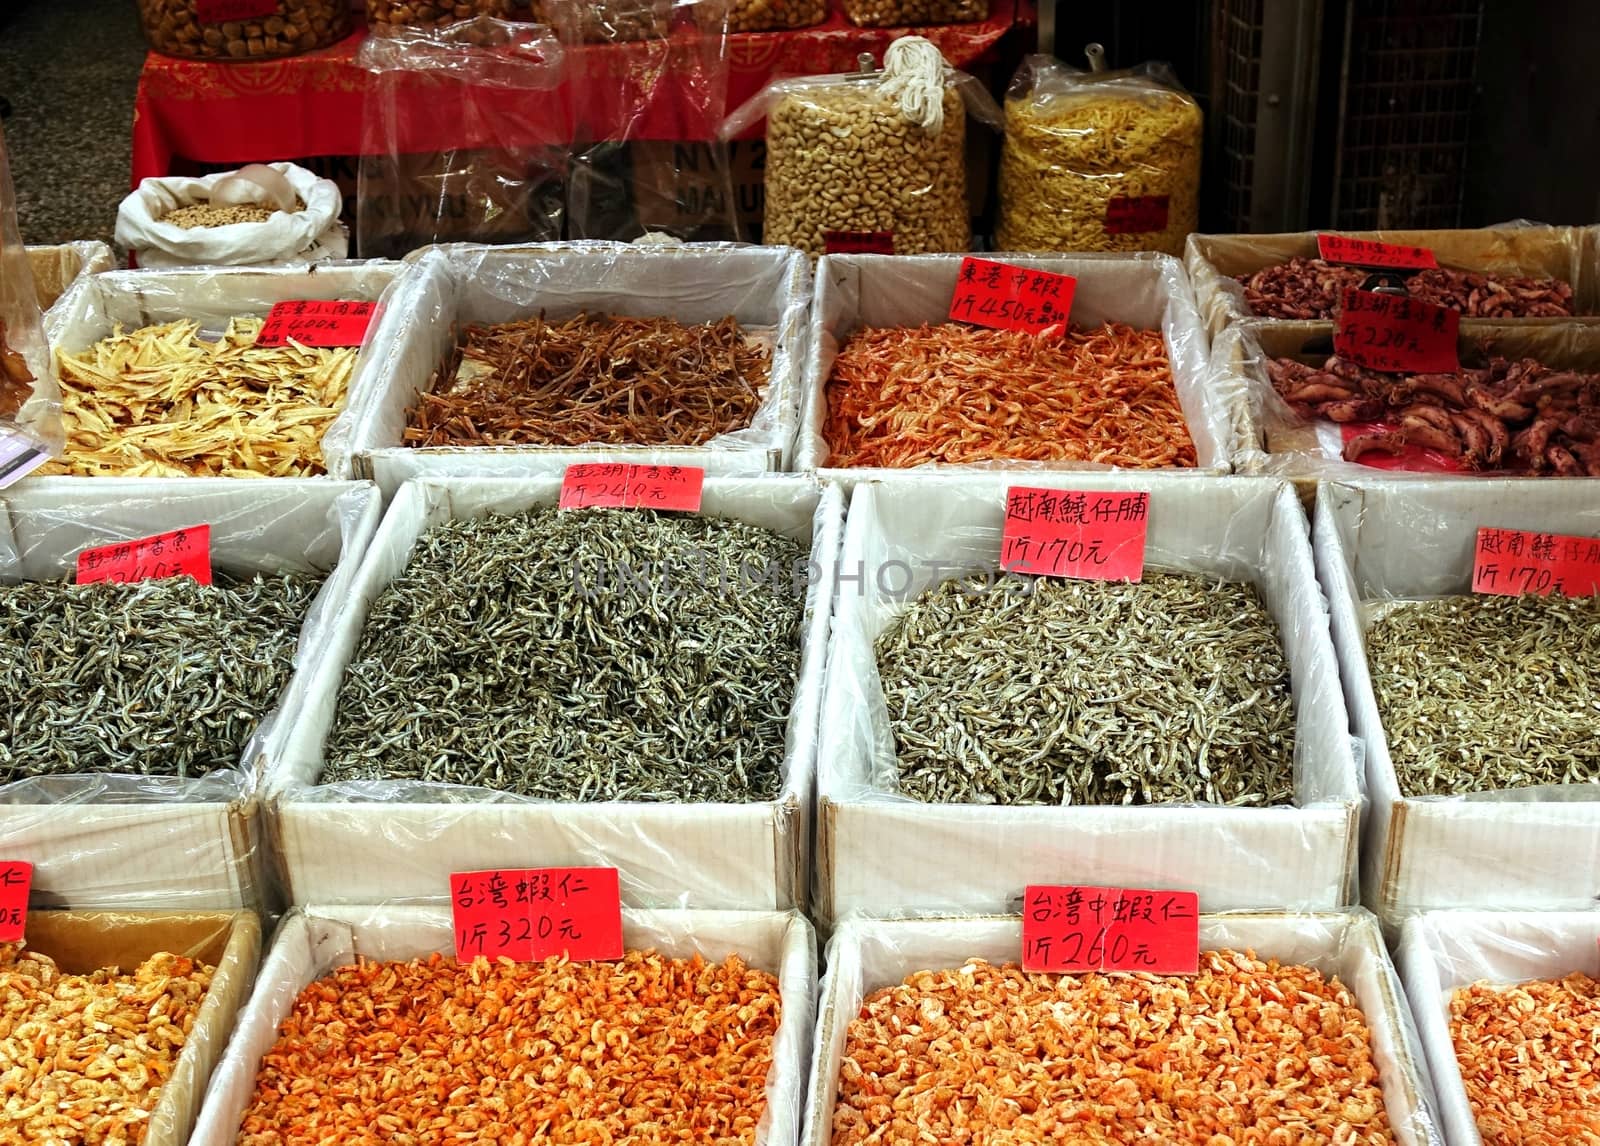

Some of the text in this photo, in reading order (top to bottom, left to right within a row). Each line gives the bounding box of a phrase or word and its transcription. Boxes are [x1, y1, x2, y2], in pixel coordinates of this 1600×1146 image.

[961, 262, 1063, 297] 東港中蝦
[1336, 323, 1424, 353] 斤220元
[460, 915, 583, 953] 1斤320元
[1027, 927, 1158, 967] 1斤260元
